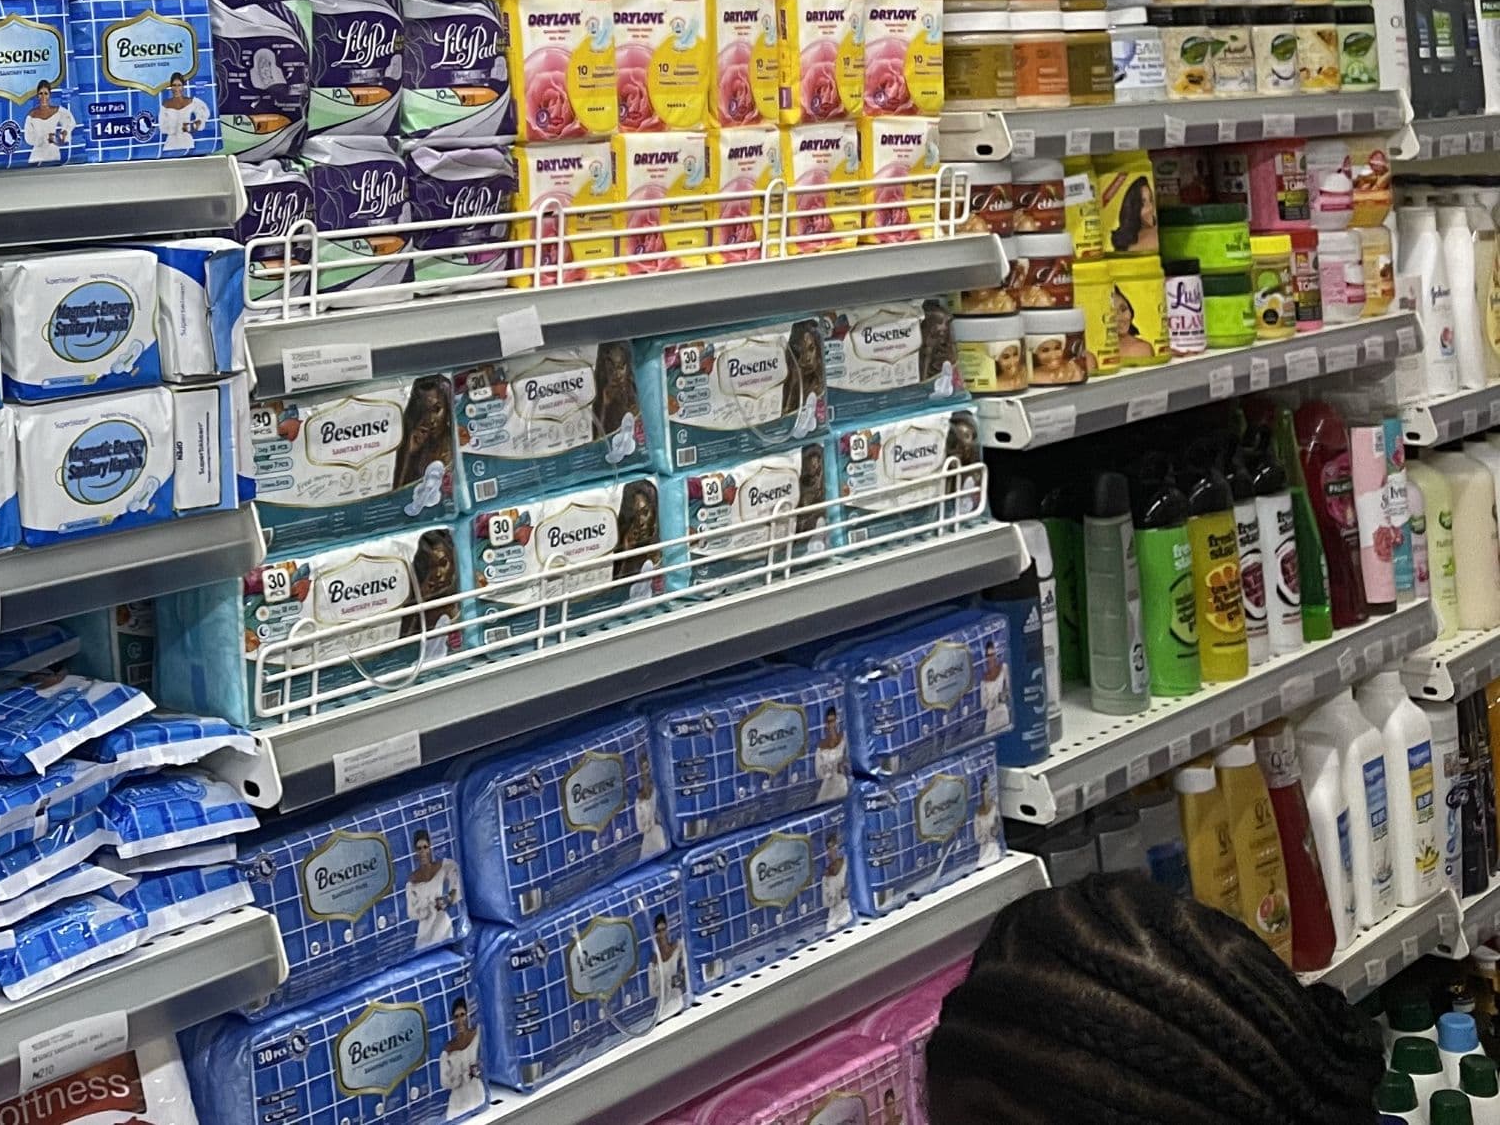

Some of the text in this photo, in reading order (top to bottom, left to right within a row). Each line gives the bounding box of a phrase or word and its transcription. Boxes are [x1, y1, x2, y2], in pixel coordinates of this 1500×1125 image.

[528, 12, 582, 27] DRYLOVE
[723, 9, 759, 23] DRYLOVE
[869, 8, 918, 21] DRYLOVE
[117, 39, 185, 58] Besense
[634, 150, 680, 166] DRYLOVE
[864, 326, 911, 343] Besense
[728, 357, 779, 377] Besense
[321, 417, 390, 443] Besense
[548, 523, 605, 547] Besense
[268, 574, 286, 589] 30
[328, 578, 397, 603] Besense
[315, 856, 378, 891] Besense
[348, 1025, 414, 1065] Besense
